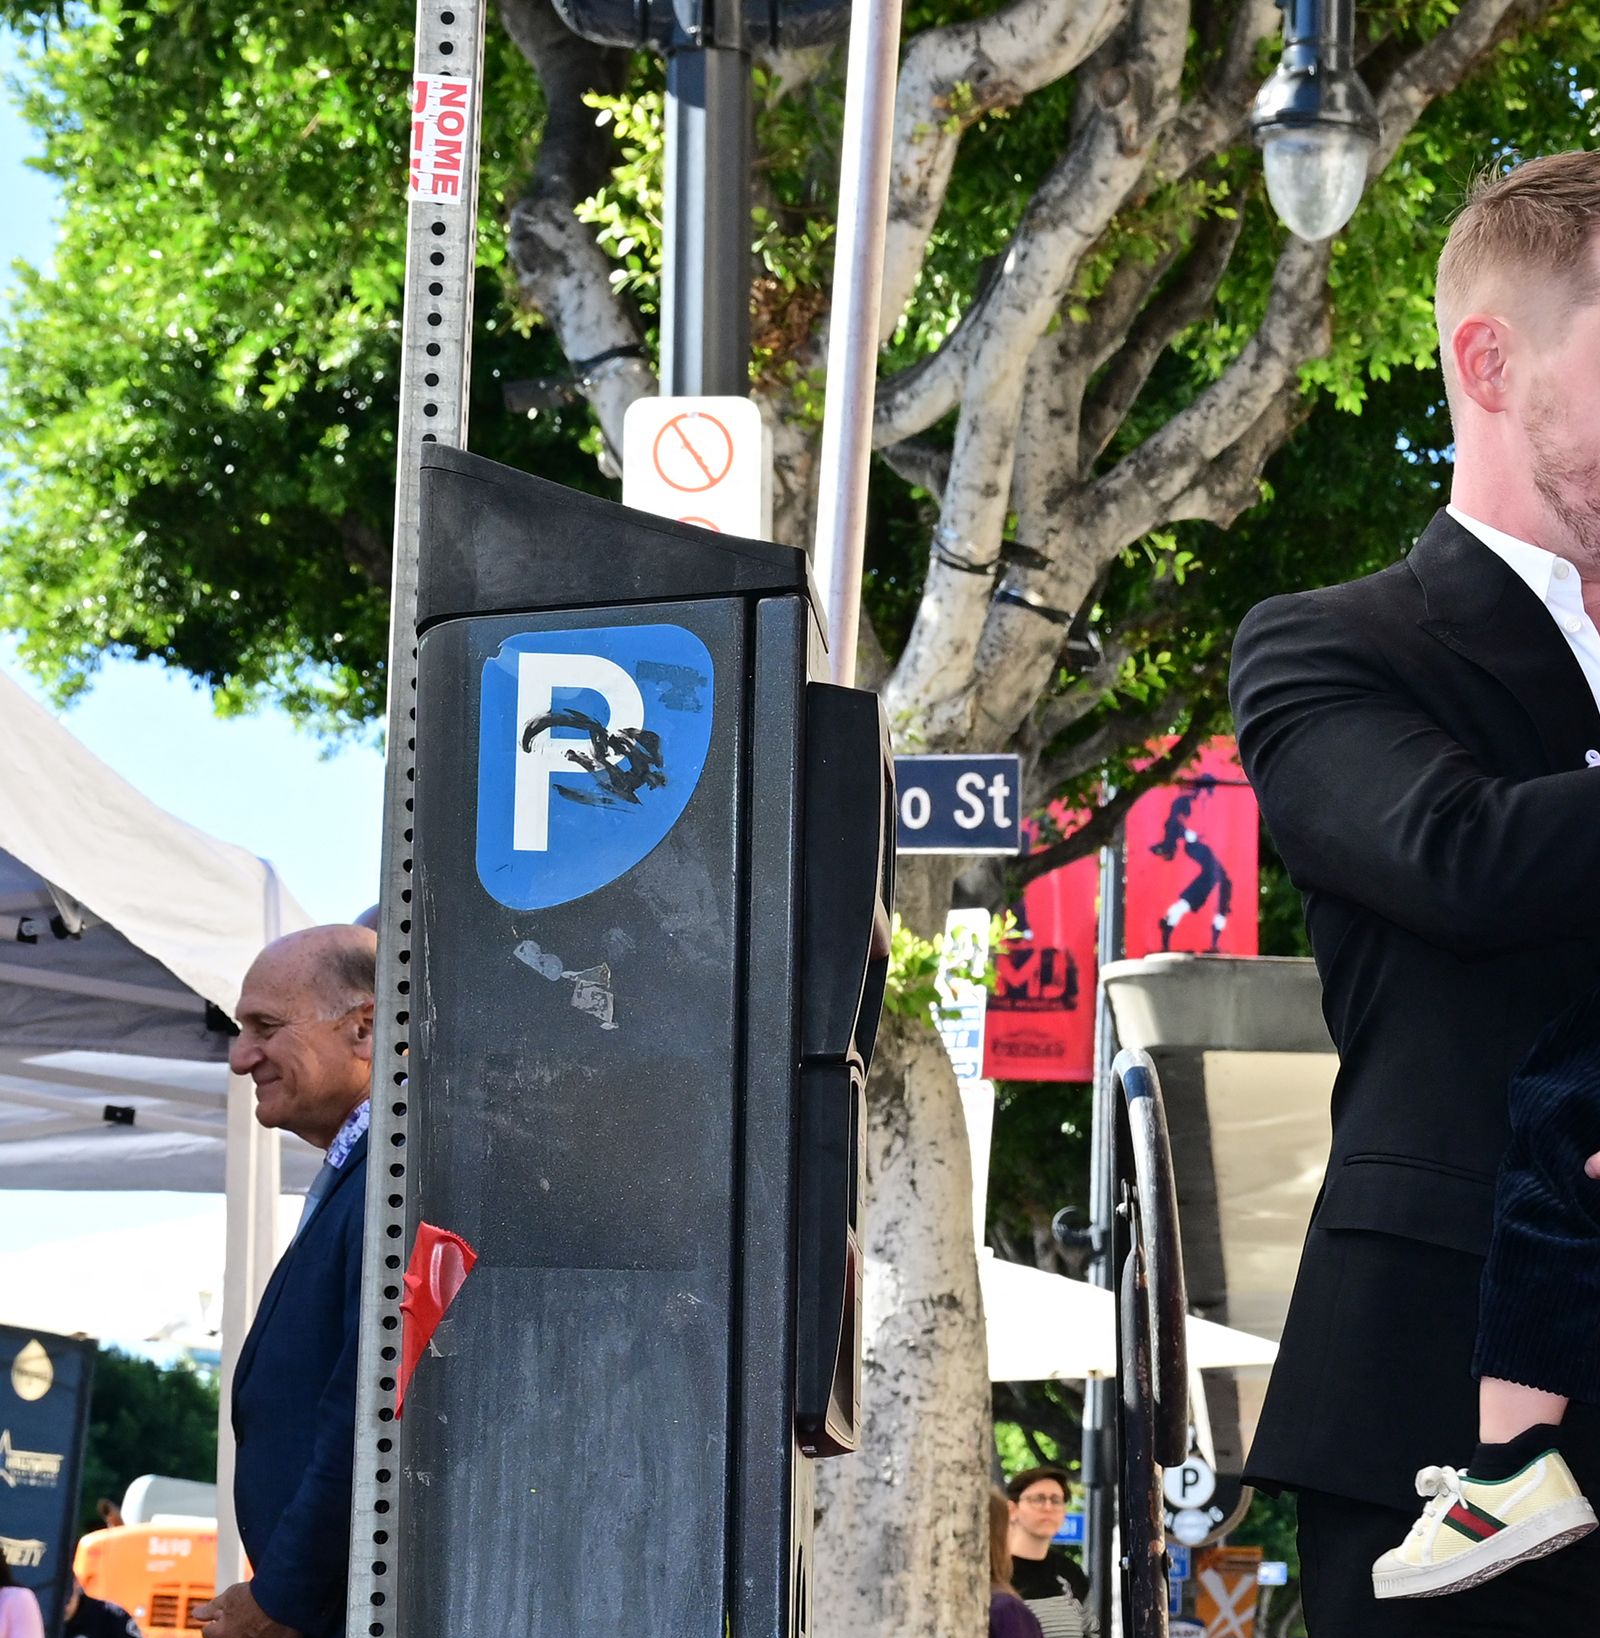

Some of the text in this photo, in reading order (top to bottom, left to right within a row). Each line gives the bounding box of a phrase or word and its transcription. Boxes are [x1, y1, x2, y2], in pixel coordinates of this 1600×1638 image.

[513, 652, 645, 851] P
[953, 772, 1013, 829] St
[1181, 1468, 1200, 1499] P
